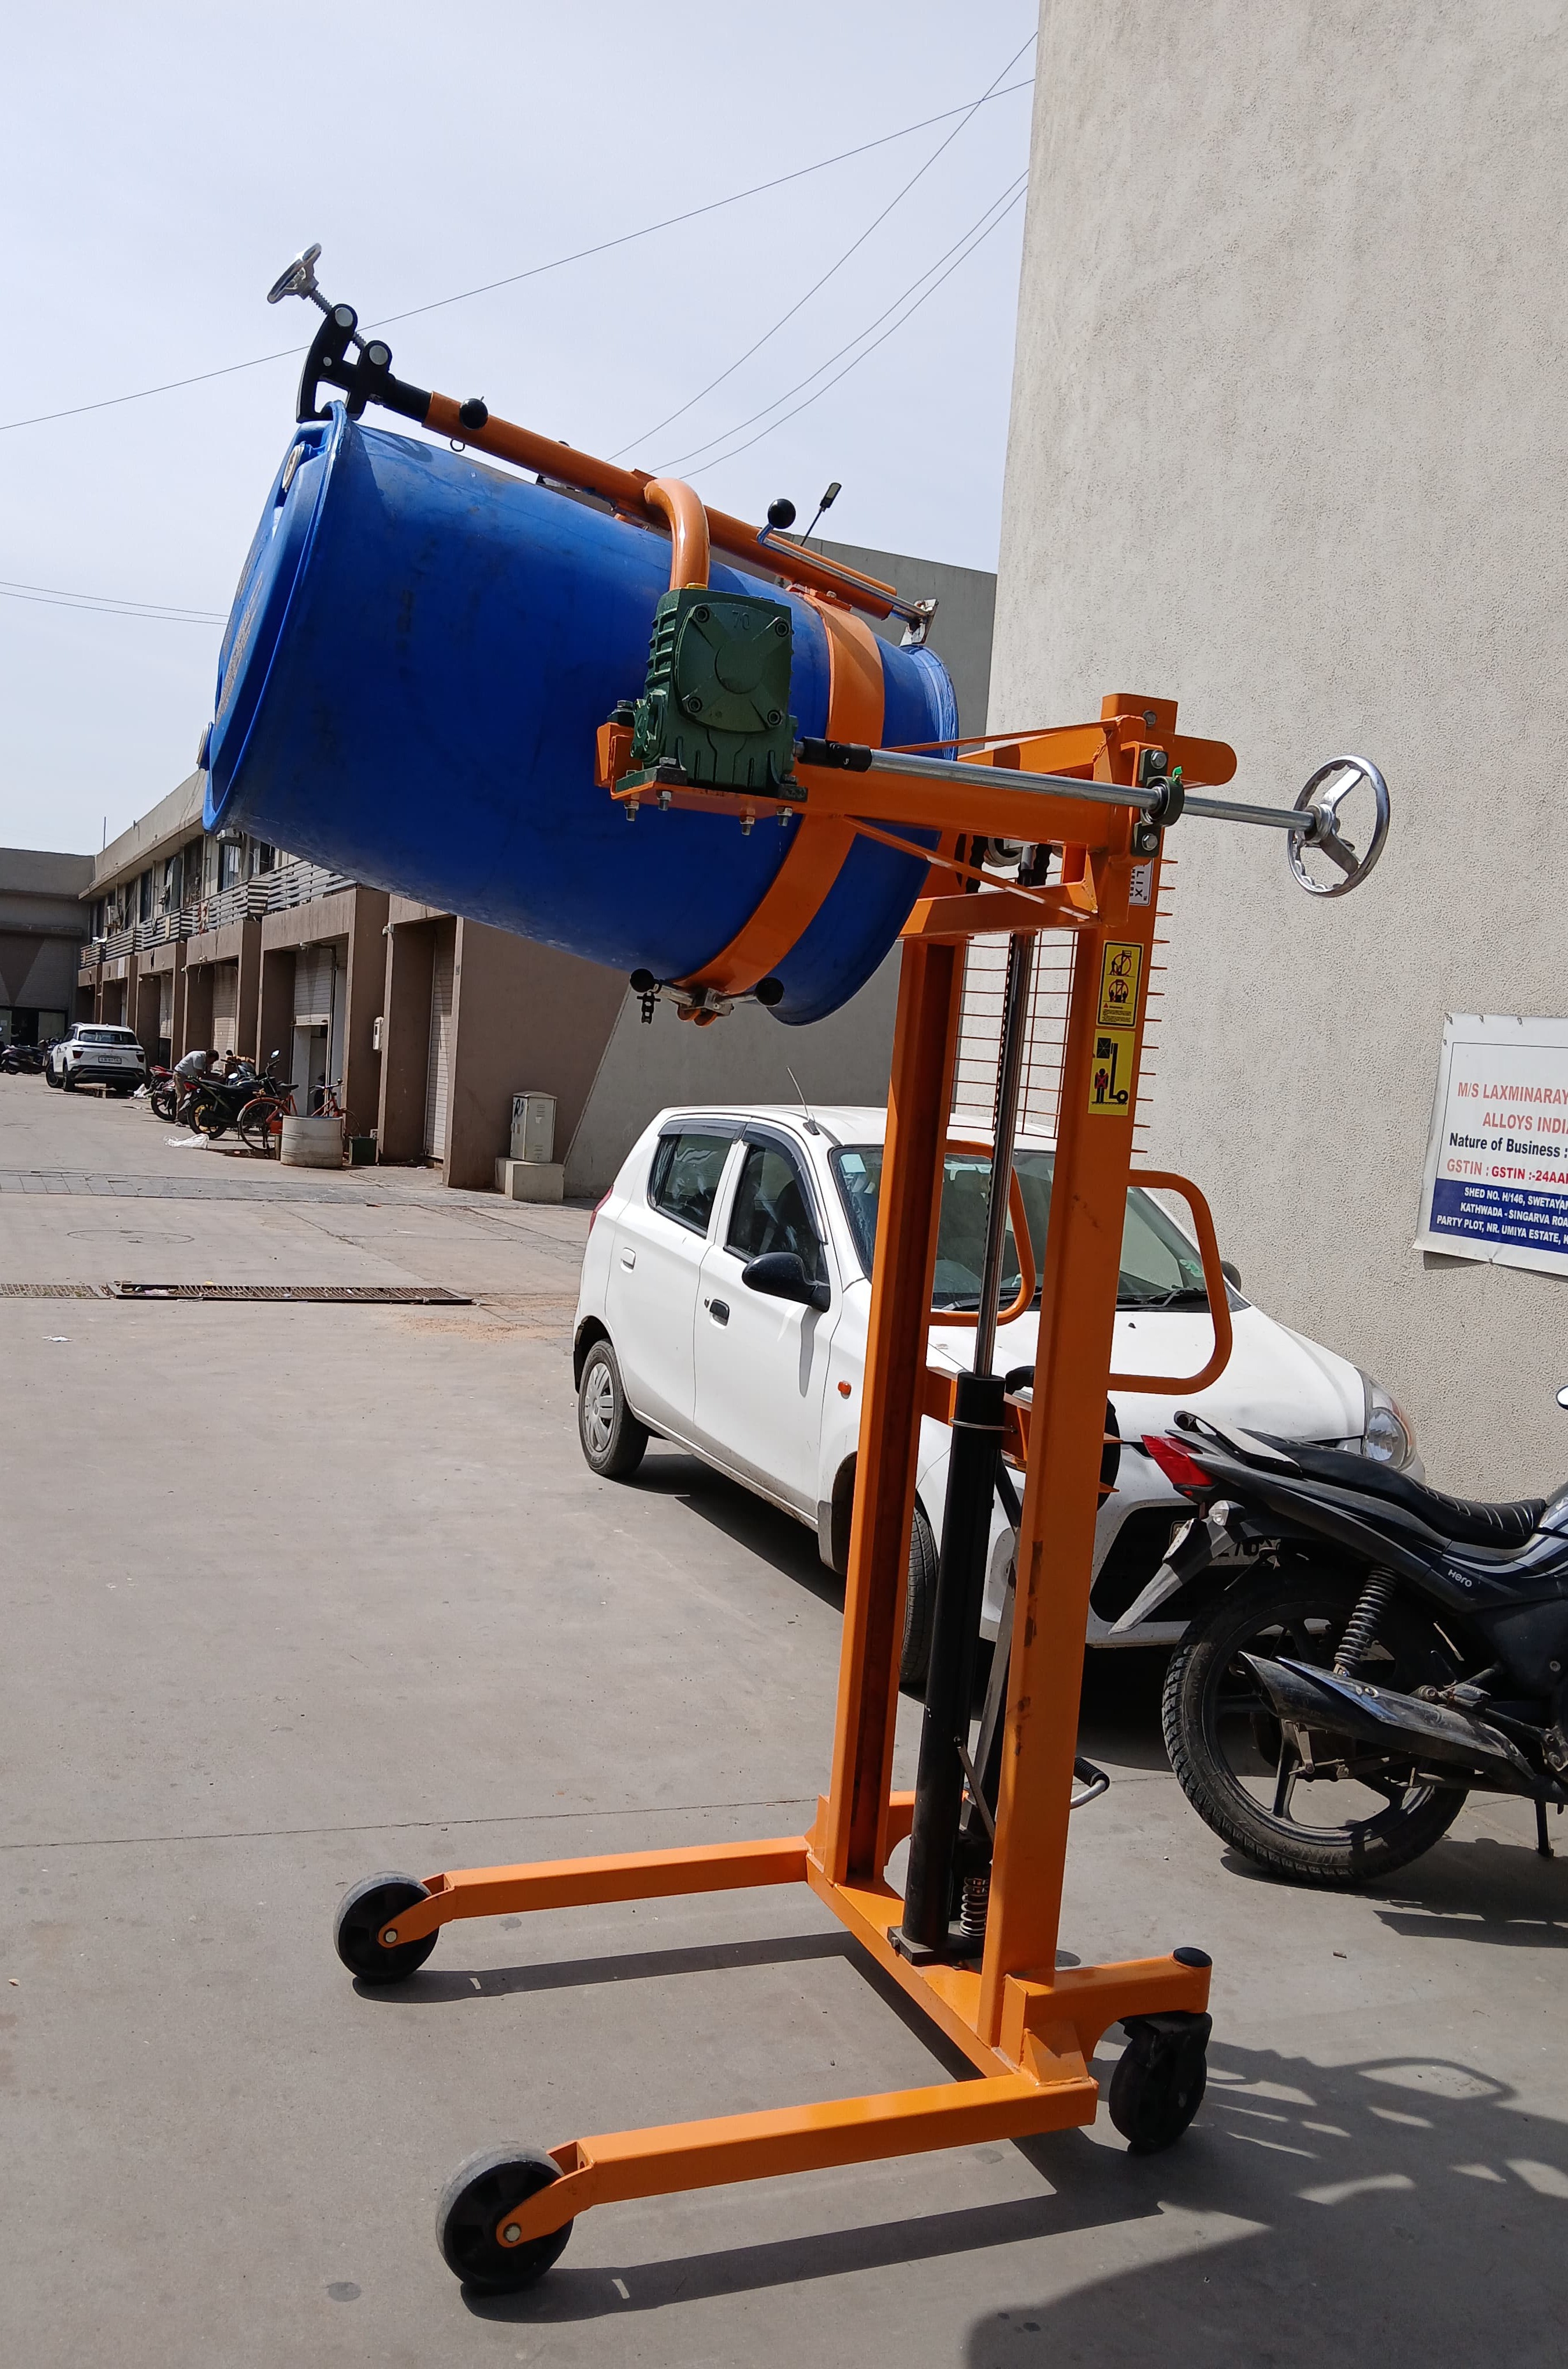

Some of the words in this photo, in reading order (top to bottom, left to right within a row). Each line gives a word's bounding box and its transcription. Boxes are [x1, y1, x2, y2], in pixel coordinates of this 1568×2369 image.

[1135, 865, 1145, 898] LIX
[1458, 1082, 1479, 1098] M/S
[1483, 1083, 1568, 1105] LAXMINARAY
[1482, 1112, 1533, 1131] ALLOYS
[1537, 1116, 1568, 1135] INDI
[1449, 1132, 1488, 1150] Nature
[1491, 1137, 1504, 1151] of
[1506, 1138, 1561, 1158] Business
[1447, 1158, 1483, 1175] GSTIN
[1491, 1165, 1526, 1180] GSTIN
[1464, 1187, 1486, 1198] SHED
[1486, 1190, 1500, 1201] NO.
[1502, 1191, 1526, 1207] H/146,
[1460, 1202, 1503, 1218] KATHWADA
[1508, 1209, 1550, 1225] SINGARVA
[1436, 1215, 1463, 1227] PARTY
[1464, 1219, 1484, 1233] PLOT,
[1486, 1222, 1500, 1233] NR.
[1501, 1225, 1527, 1238] UMIYA
[1529, 1229, 1561, 1245] ESTATE,
[1447, 1569, 1473, 1588] Hero
